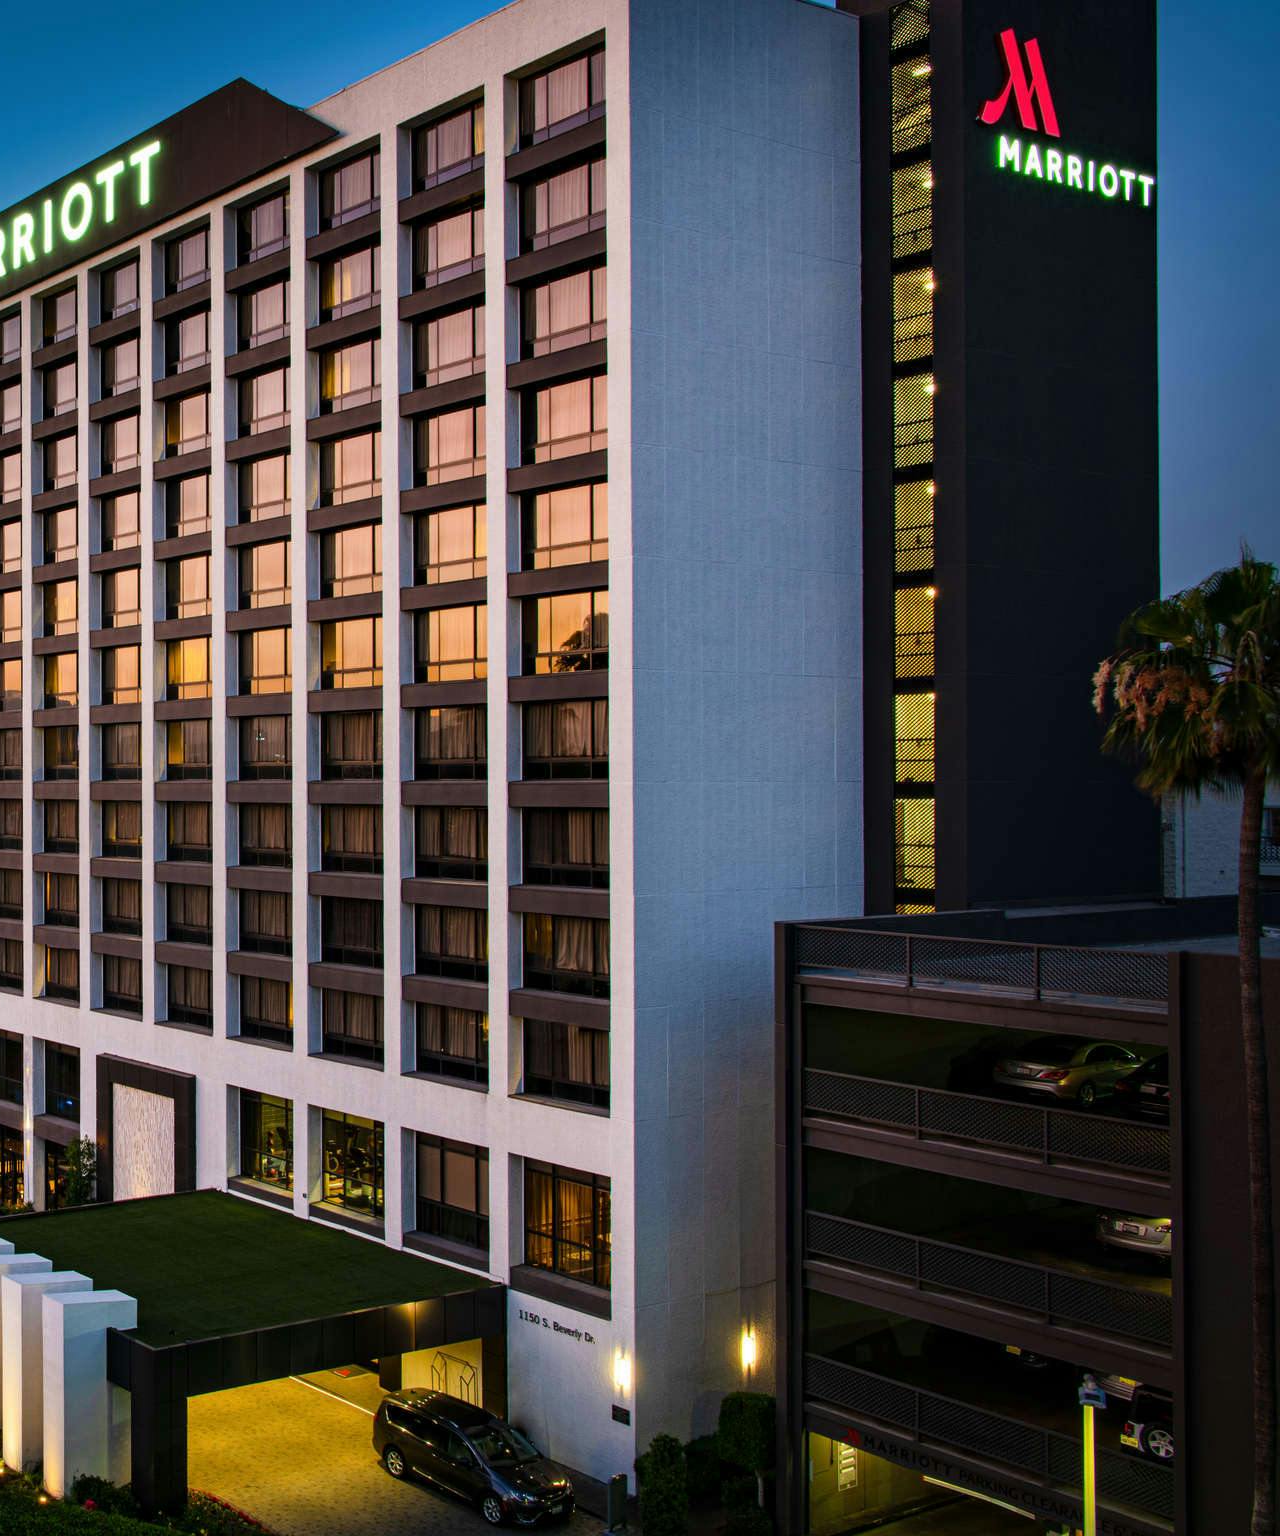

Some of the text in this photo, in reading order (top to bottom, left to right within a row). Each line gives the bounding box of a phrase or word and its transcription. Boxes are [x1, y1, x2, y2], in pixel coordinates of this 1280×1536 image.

[998, 135, 1154, 207] MARRIOTT
[519, 1309, 596, 1344] 1150 S. Beverly Dr.
[864, 1435, 953, 1476] MARRIOTT
[959, 1469, 1018, 1500] PARKING
